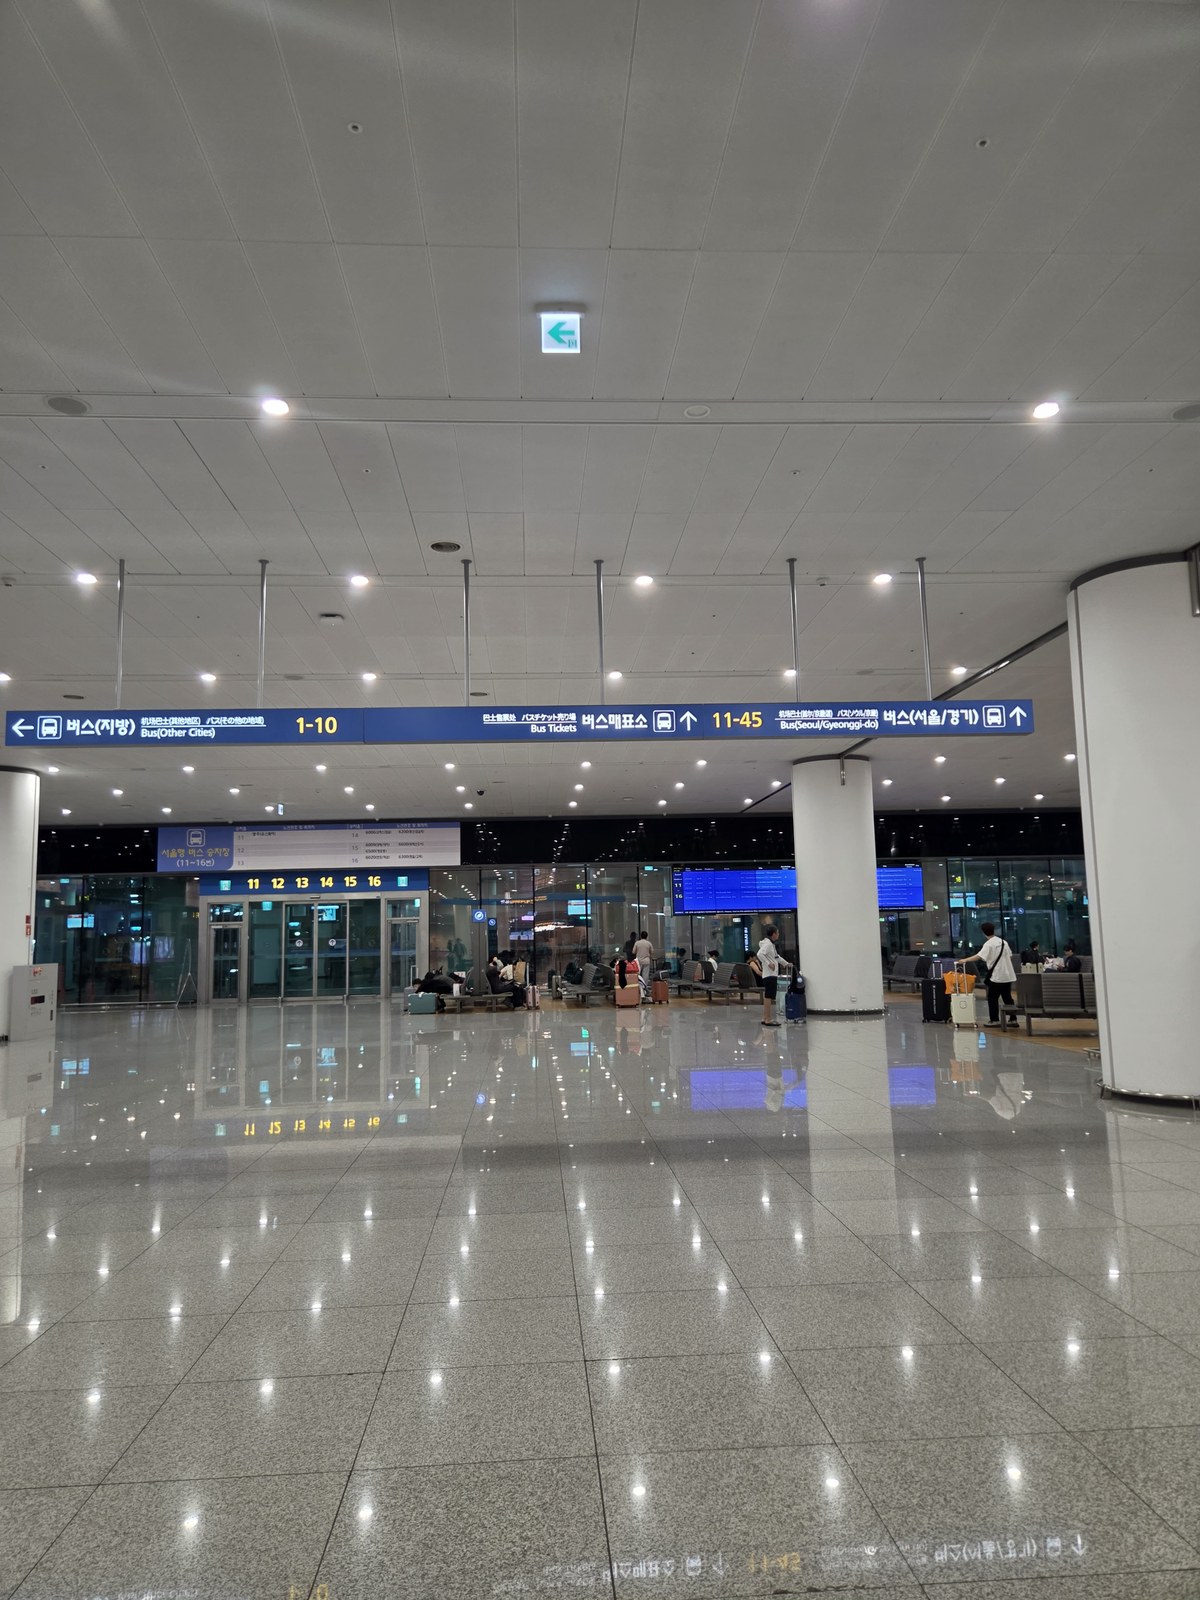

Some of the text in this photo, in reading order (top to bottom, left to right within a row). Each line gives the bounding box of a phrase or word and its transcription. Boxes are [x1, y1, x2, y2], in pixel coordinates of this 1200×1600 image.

[582, 713, 648, 730] 버스매표소
[712, 711, 763, 728] 11-45
[780, 718, 879, 731] Bus(Seoul/Gyeonggi-do)
[884, 707, 980, 726] 버스(서울/경기)
[66, 718, 136, 737] 버스(지방)
[140, 727, 216, 739] Bus(Other Cities)
[296, 716, 338, 734] 1-10
[530, 721, 577, 733] Bus Tickets
[161, 848, 185, 858] 서울행
[188, 848, 204, 857] 버스
[247, 874, 382, 890] 11 12 13 14 15 16
